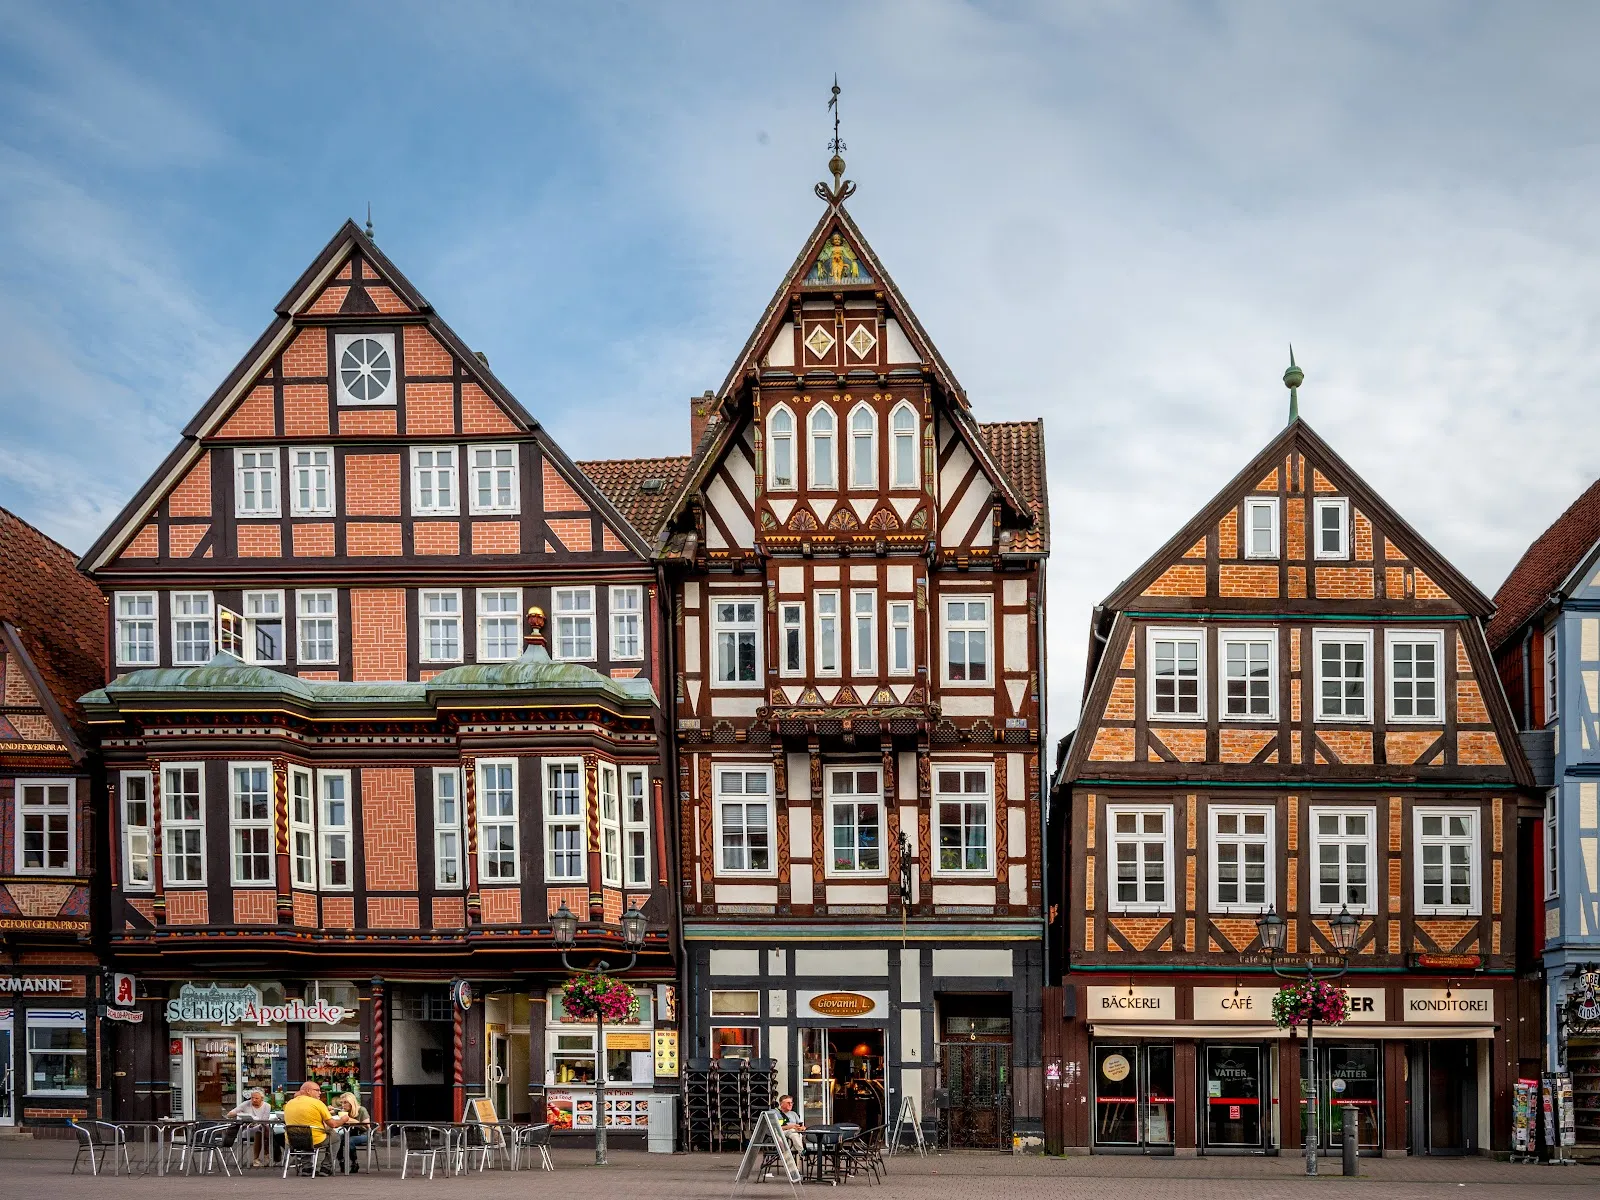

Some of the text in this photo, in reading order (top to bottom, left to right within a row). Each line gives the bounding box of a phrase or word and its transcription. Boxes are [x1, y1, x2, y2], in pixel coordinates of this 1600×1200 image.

[1262, 955, 1300, 964] Kremer
[817, 998, 871, 1009] Giovanni L.
[1102, 995, 1160, 1009] BÄCKEREI
[1221, 994, 1253, 1010] CAFÉ
[1410, 999, 1488, 1011] KONDITOREI
[168, 1001, 339, 1025] Schloß Apotheke
[1579, 1003, 1600, 1019] KIOSK
[1214, 1069, 1247, 1077] VATTER
[1335, 1070, 1368, 1078] VATTER
